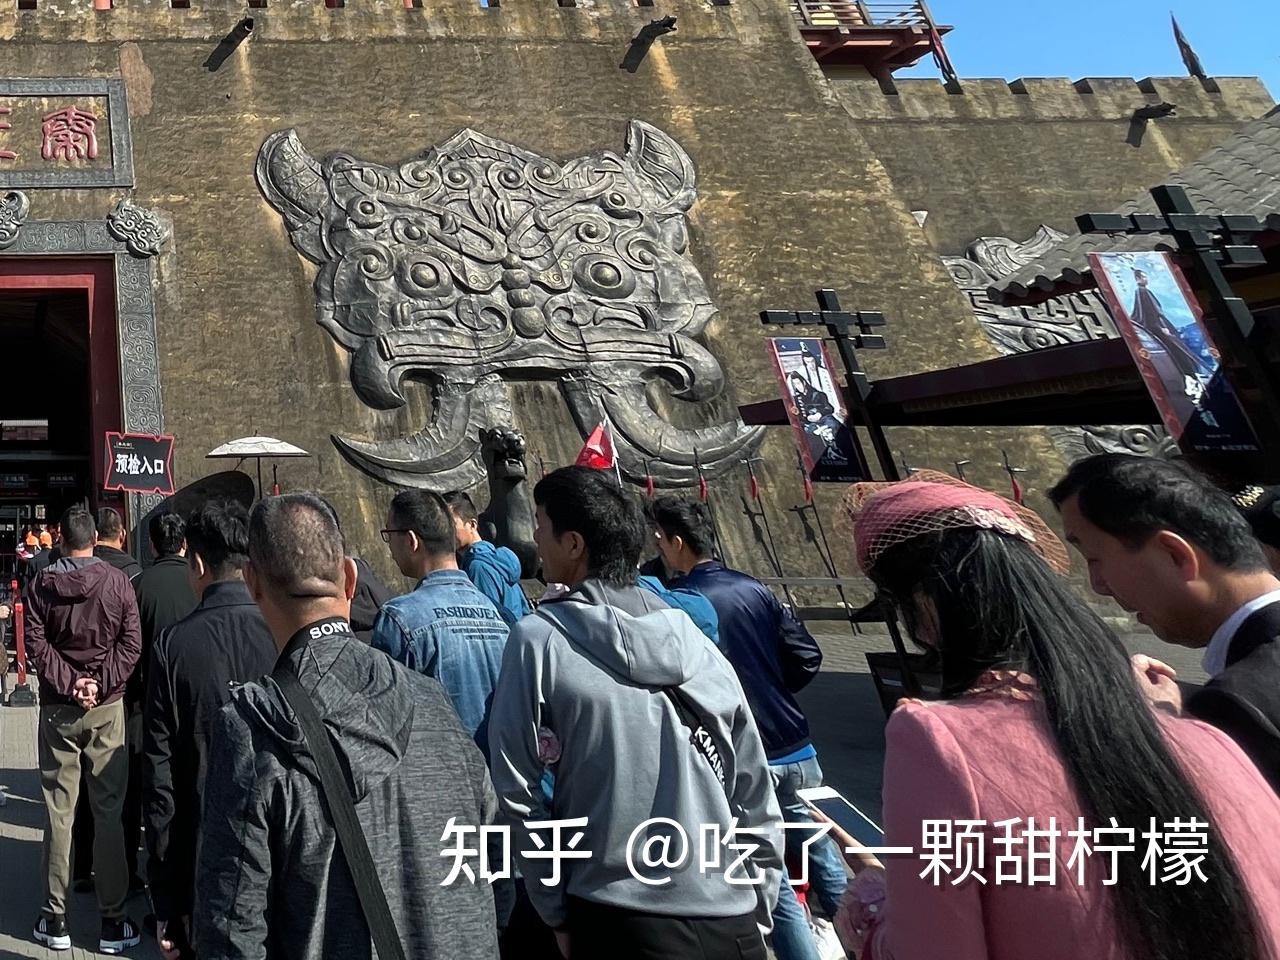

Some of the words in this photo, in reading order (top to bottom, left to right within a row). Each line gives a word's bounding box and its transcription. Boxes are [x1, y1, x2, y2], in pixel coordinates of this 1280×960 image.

[115, 453, 164, 475] 预检入口
[310, 621, 350, 639] SONY
